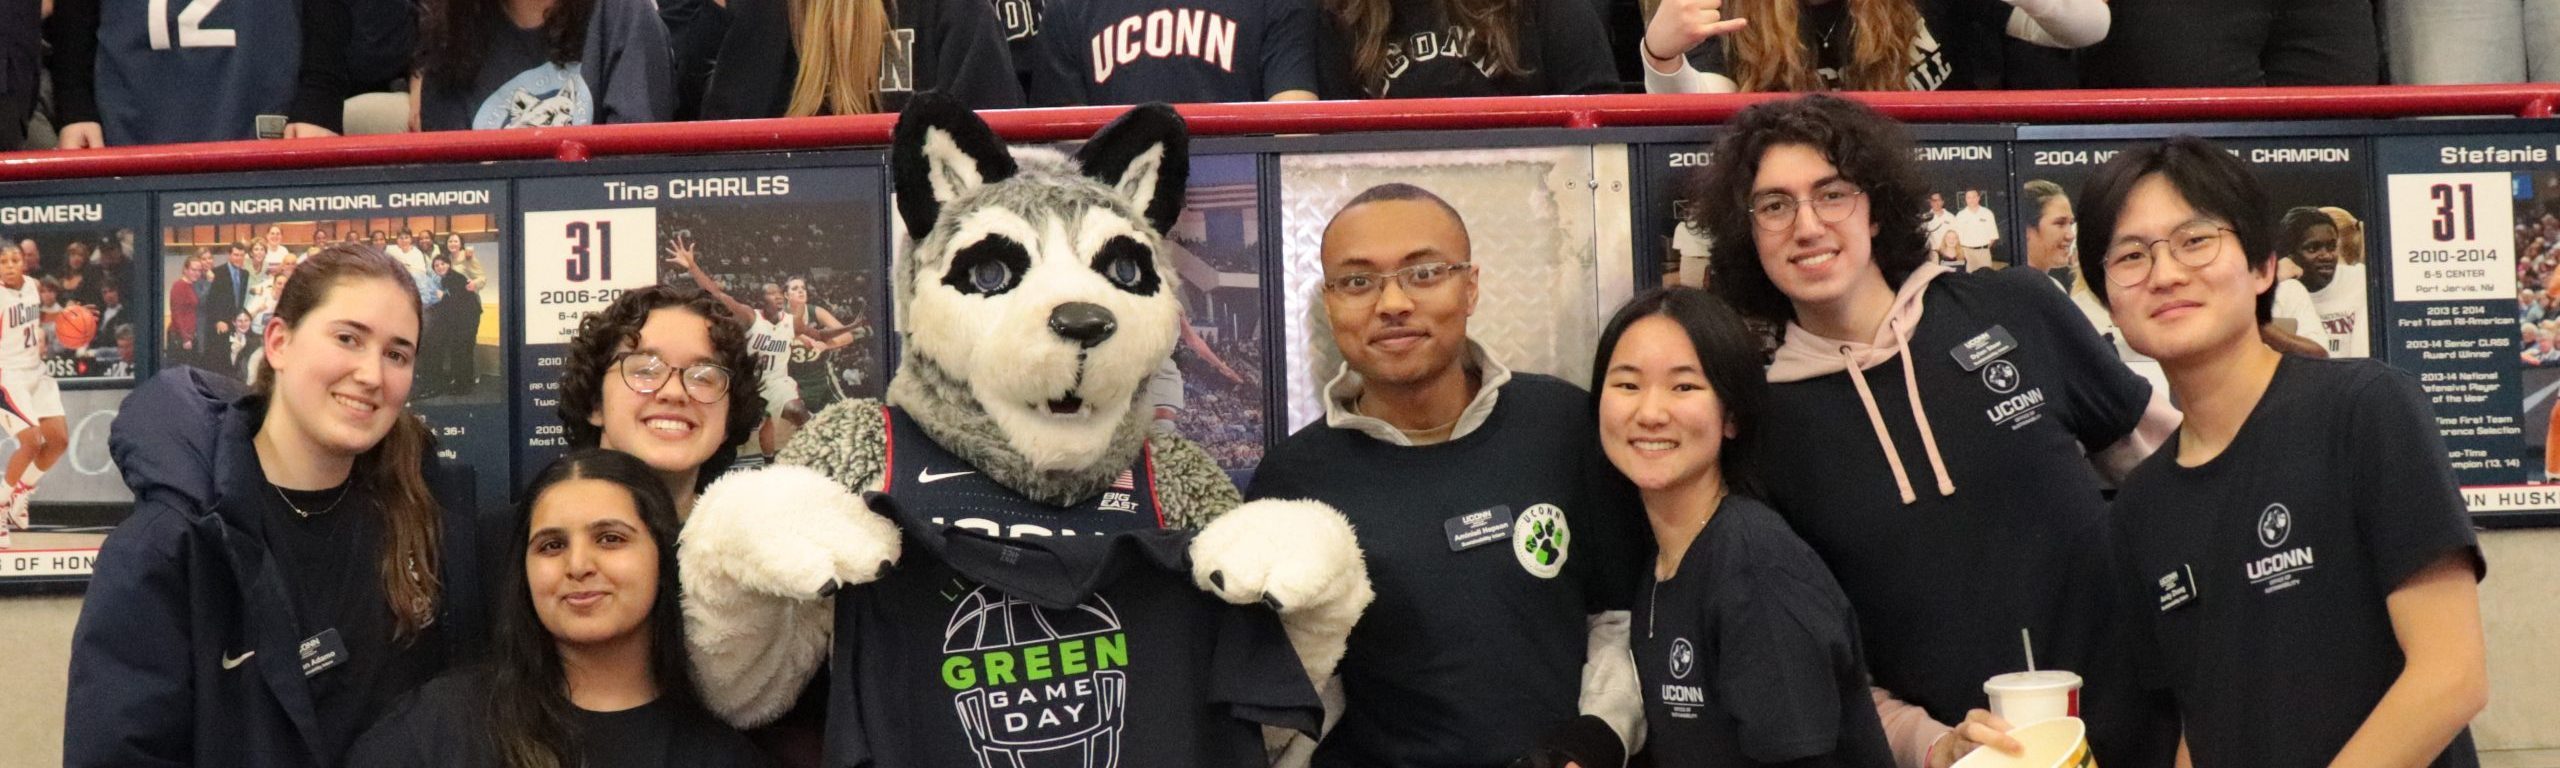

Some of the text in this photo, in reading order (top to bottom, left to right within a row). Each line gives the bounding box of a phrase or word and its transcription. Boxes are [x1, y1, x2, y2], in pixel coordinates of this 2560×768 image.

[1091, 8, 1237, 84] UCONN
[1669, 152, 1714, 167] 200
[2034, 150, 2088, 166] 2004
[2251, 148, 2349, 163] CHAMPION
[2440, 146, 2547, 164] Stefanie
[603, 176, 789, 201] Tina CHARLES
[173, 190, 490, 217] 2000 NCAA NATIONAL CHAMPION
[0, 203, 103, 225] GOMERY
[2430, 183, 2475, 242] 31
[566, 220, 612, 282] 31
[2408, 249, 2497, 263] 2010-2014
[2424, 269, 2485, 278] 6-5 CENTER
[2416, 285, 2438, 293] Port
[558, 311, 578, 321] 6-4
[2426, 306, 2450, 315] 2013
[2462, 306, 2485, 314] 2014
[2425, 318, 2452, 326] Team
[2406, 340, 2442, 349] 2013-14
[2444, 339, 2475, 348] Senior
[537, 357, 562, 366] 2010
[2421, 371, 2498, 382] 2013-14 National
[1986, 387, 2044, 422] UCONN
[2445, 394, 2462, 402] the
[535, 425, 563, 434] 2009
[529, 438, 555, 446] Most
[1102, 492, 1131, 501] BIG
[1099, 500, 1139, 510] EAST
[1523, 506, 1561, 524] UCONN
[15, 557, 39, 571] OF
[2246, 546, 2314, 579] UCONN
[941, 633, 1129, 690] GREEN
[988, 678, 1092, 709] GAME
[1662, 684, 1704, 702] UCONN
[1004, 703, 1085, 733] DAY
